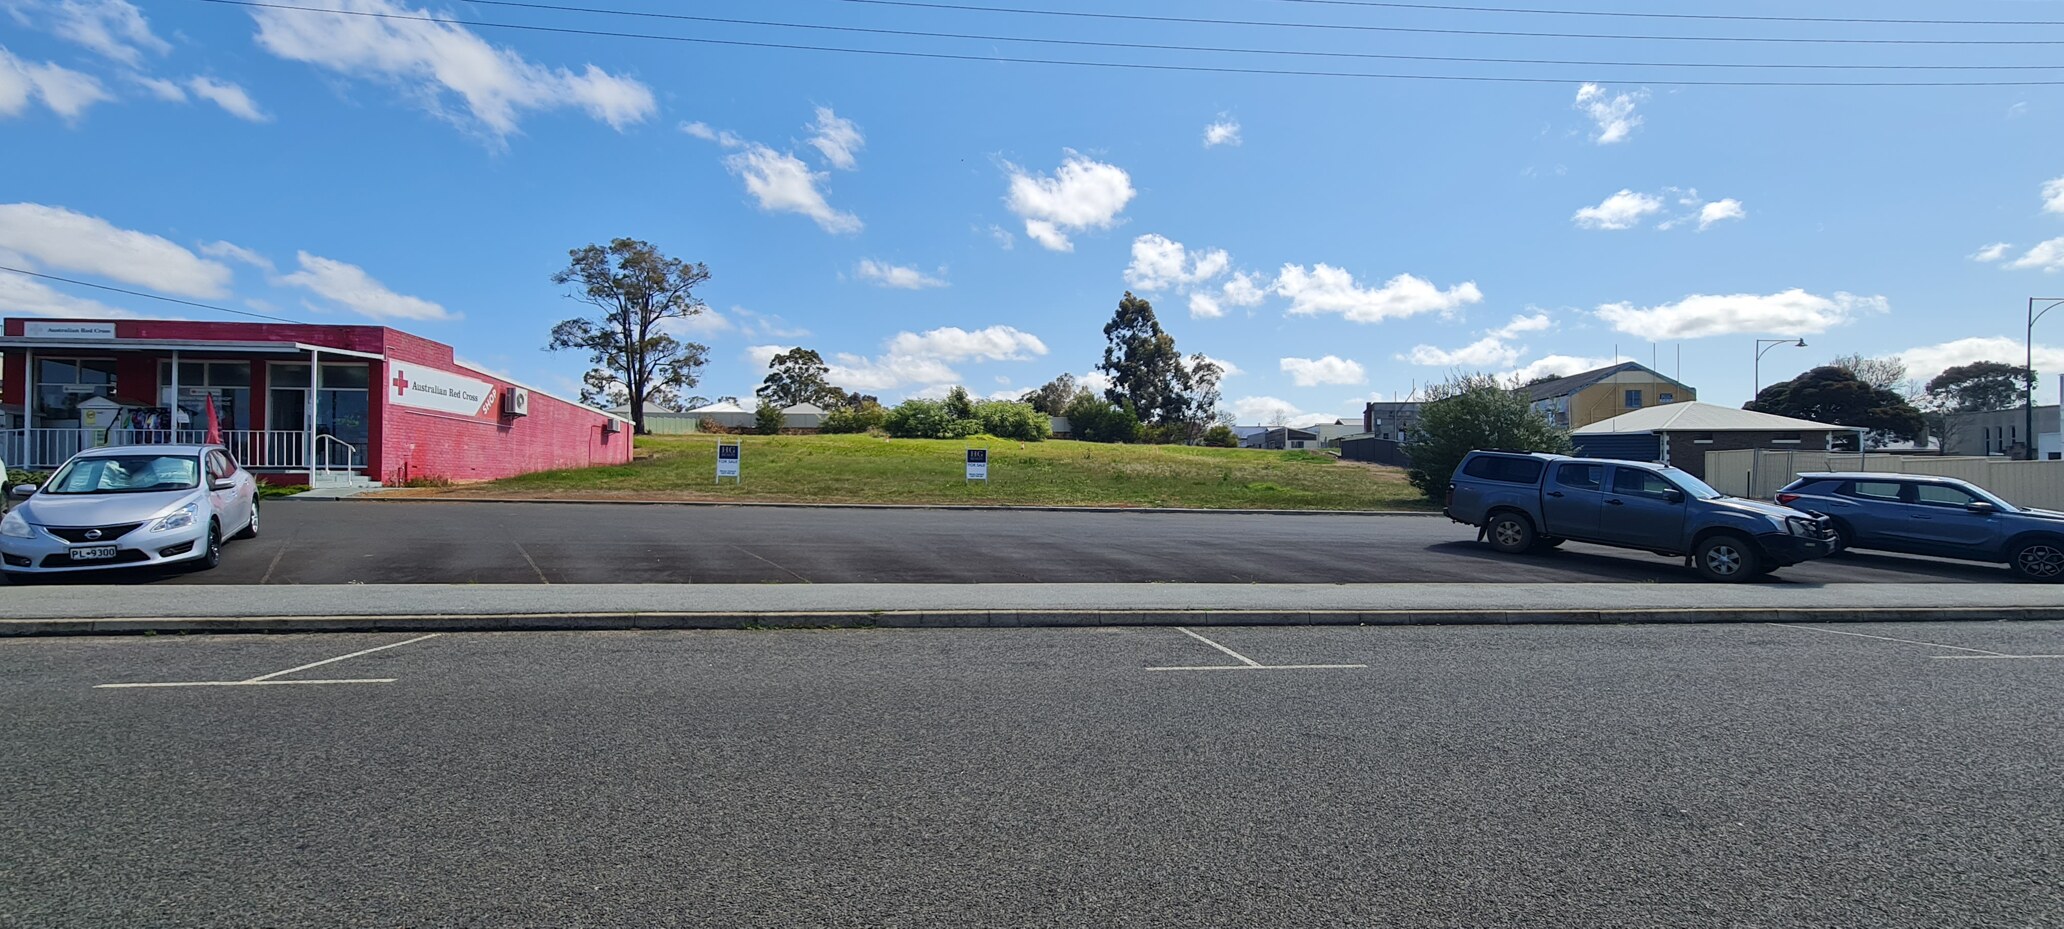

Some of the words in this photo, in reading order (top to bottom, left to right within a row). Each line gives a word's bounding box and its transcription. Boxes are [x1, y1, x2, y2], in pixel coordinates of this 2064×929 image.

[412, 381, 448, 396] Australian
[449, 388, 461, 399] Red
[462, 391, 479, 402] Cross
[482, 389, 497, 415] SHOP
